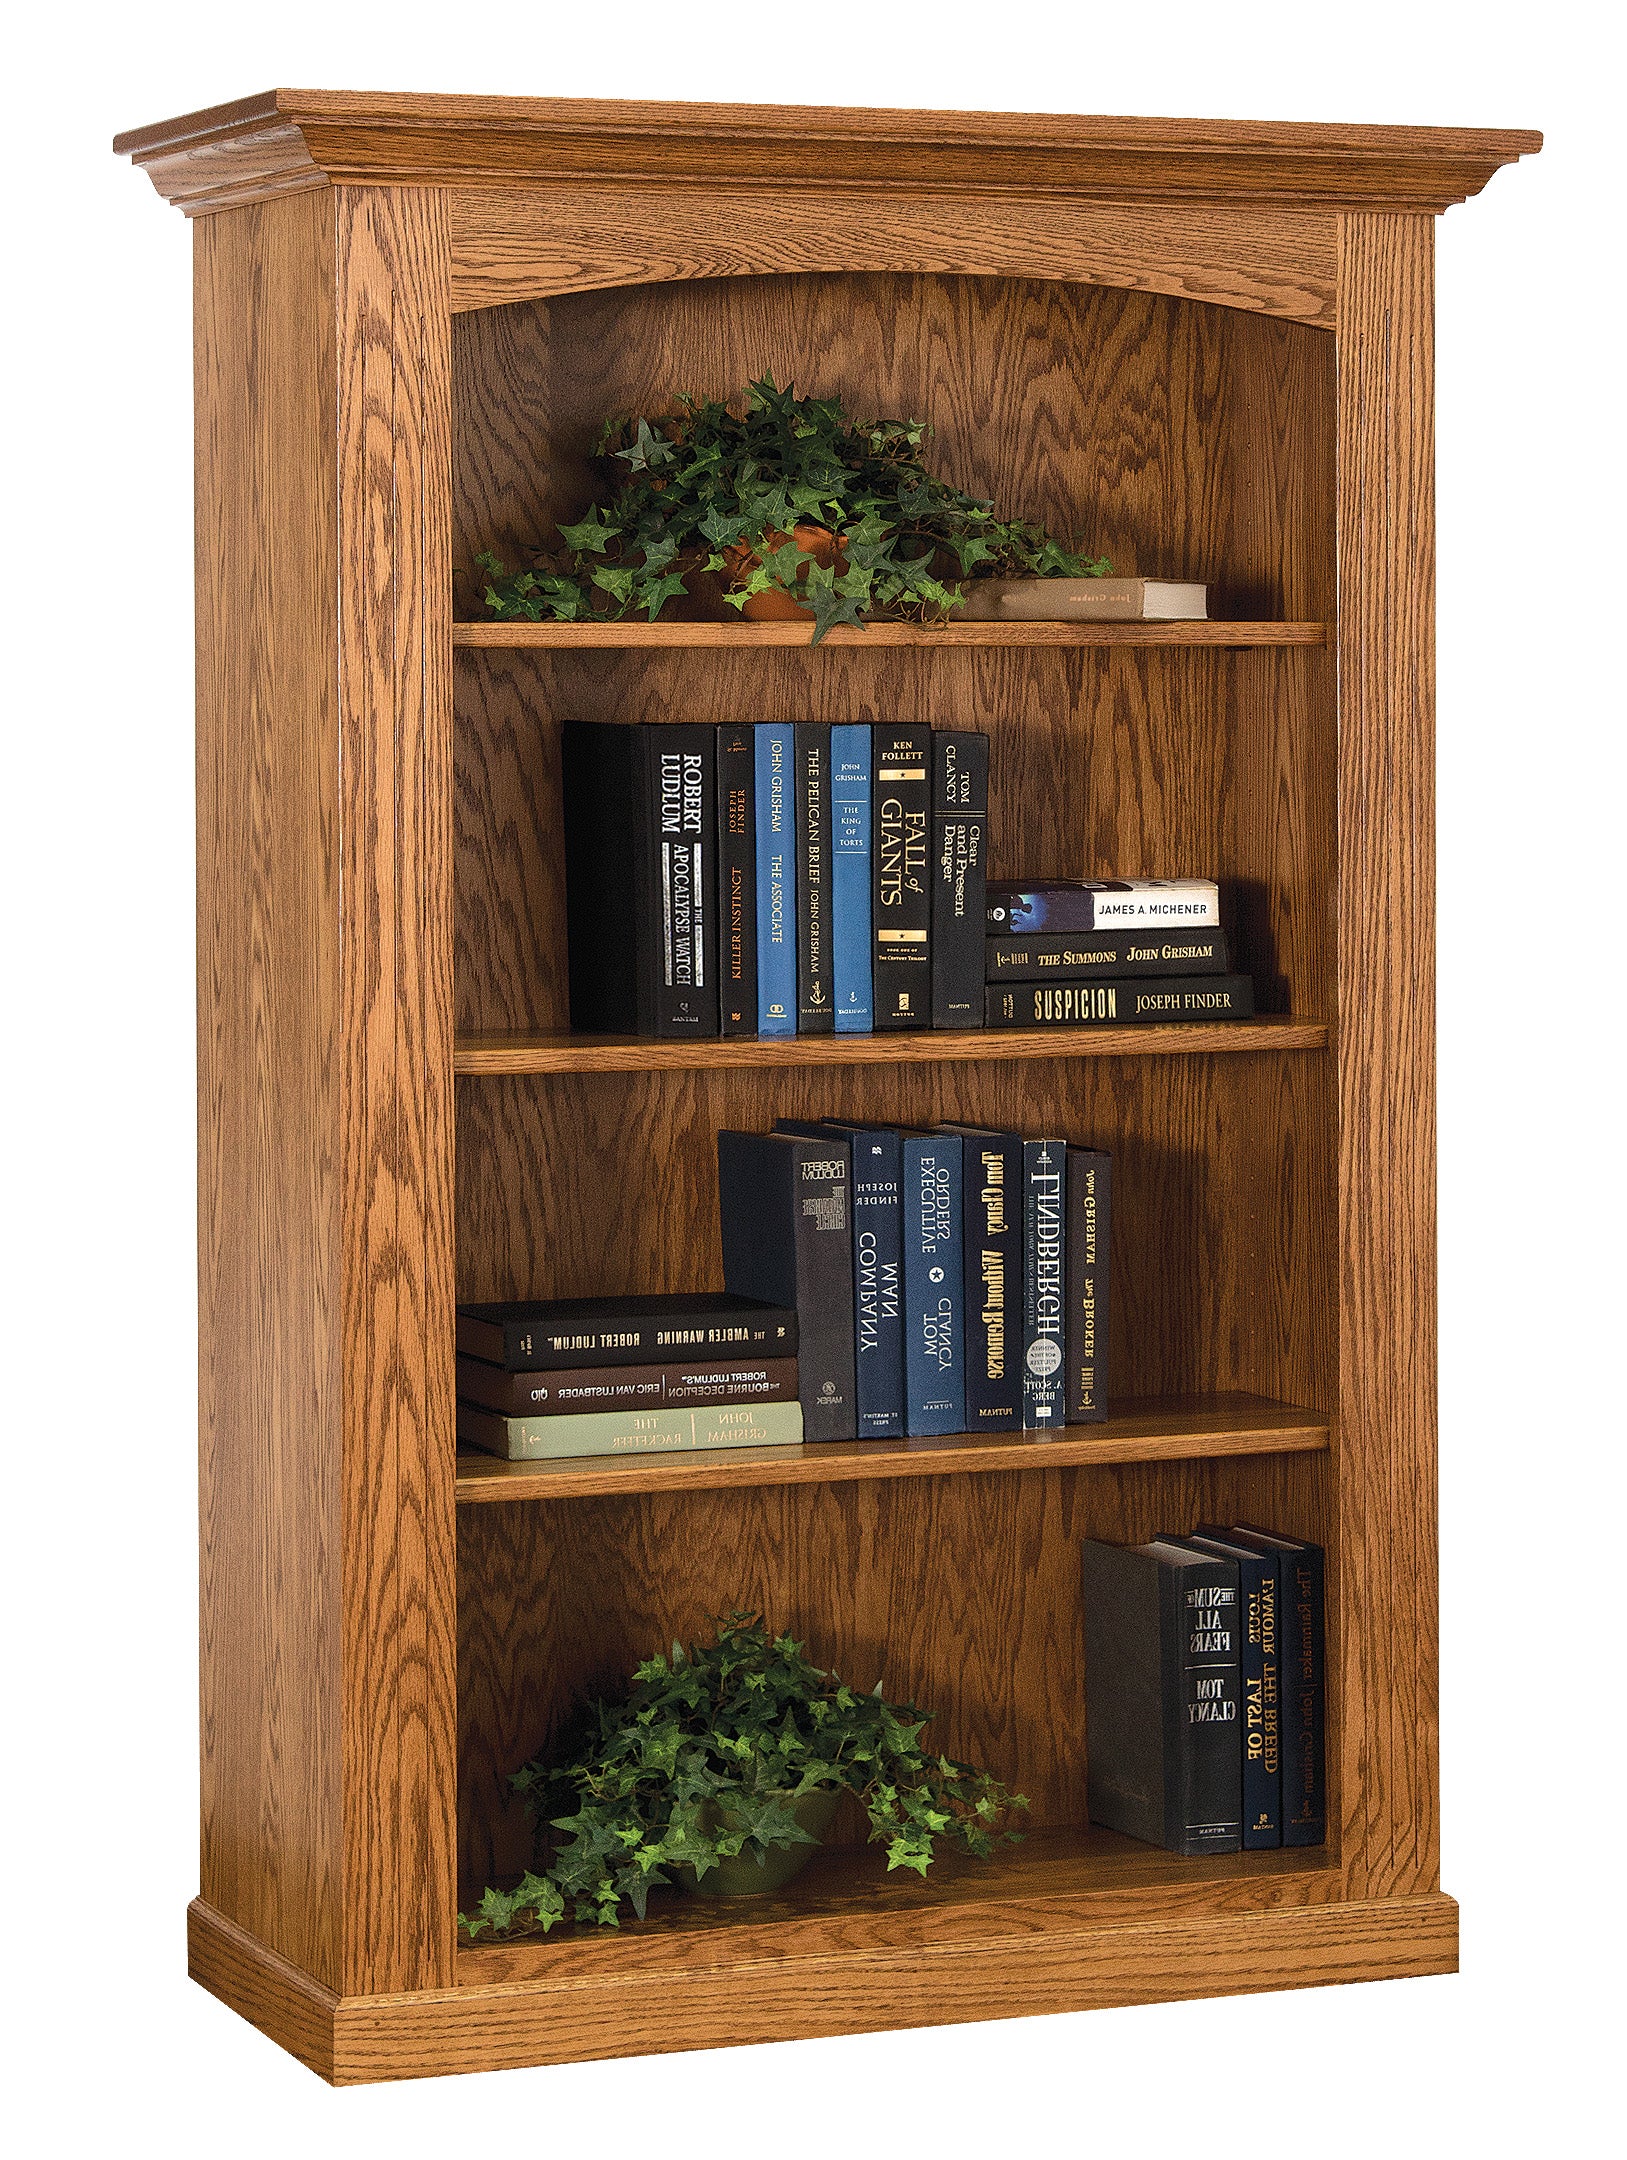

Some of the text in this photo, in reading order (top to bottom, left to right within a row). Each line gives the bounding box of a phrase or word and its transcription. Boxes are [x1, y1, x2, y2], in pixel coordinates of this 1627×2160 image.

[882, 752, 923, 760] FOLLETT
[893, 741, 913, 750] KEN
[945, 745, 957, 803] CLANCY
[661, 754, 681, 834] LUDLUM
[683, 754, 702, 834] ROBERT
[729, 790, 737, 833] JOSEPH
[737, 789, 745, 834] FINDER
[770, 740, 782, 832] JOHN GRISHAM
[960, 772, 970, 803] TOM
[808, 749, 820, 883] THE PELICAN BRIEF
[881, 798, 902, 905] GIANTS
[905, 811, 926, 893] FALL of
[941, 825, 956, 882] Danger
[955, 825, 968, 917] and Present
[969, 825, 980, 866] Clear
[673, 844, 691, 985] APOCALYPSE WATCH
[694, 908, 702, 923] THE
[732, 867, 741, 980] KILLER INSTINCT
[771, 855, 783, 943] THE ASSOCIATE
[1099, 905, 1134, 915] JAMES
[1149, 904, 1207, 914] MICHENER
[811, 890, 820, 973] JOHN GRISHAM
[1038, 954, 1060, 966] THE
[1063, 951, 1117, 965] SUMMONS
[1126, 946, 1159, 961] JOHN
[1162, 944, 1213, 960] GRISHAM
[1034, 988, 1117, 1020] SUSPICION
[1135, 993, 1232, 1014] JOSEPH FINDER
